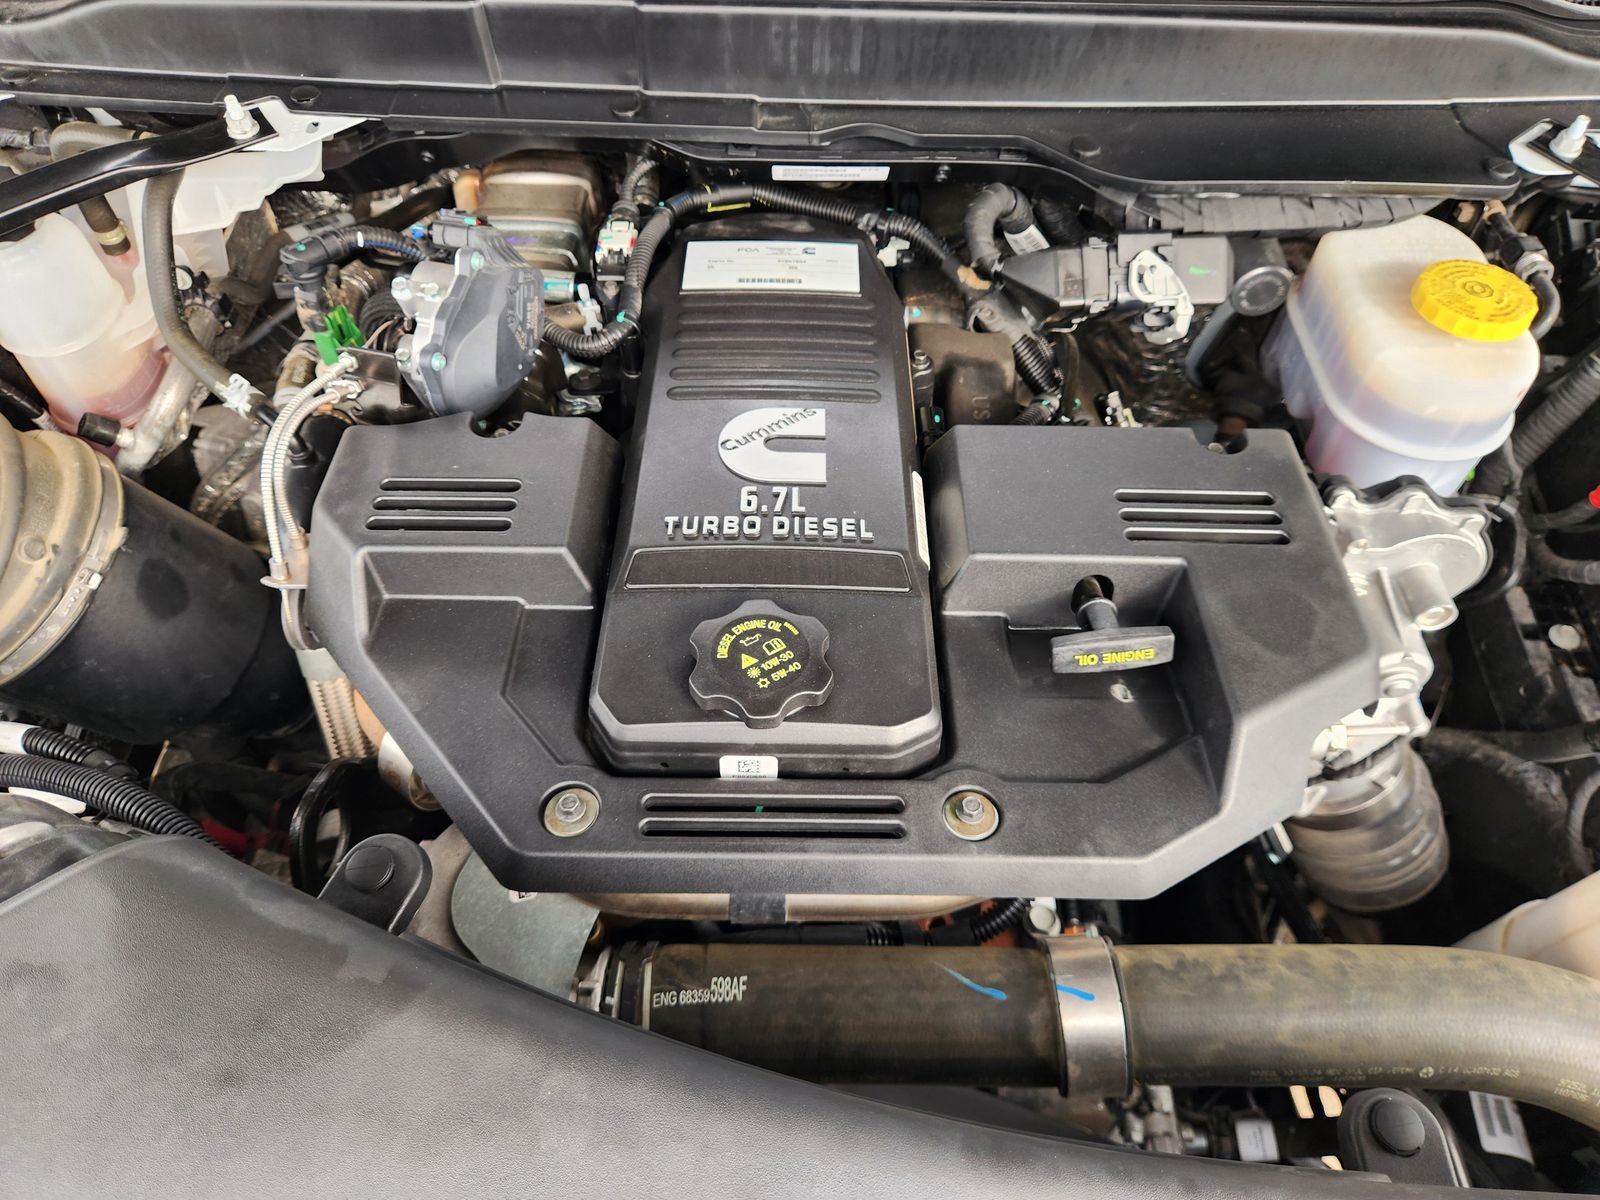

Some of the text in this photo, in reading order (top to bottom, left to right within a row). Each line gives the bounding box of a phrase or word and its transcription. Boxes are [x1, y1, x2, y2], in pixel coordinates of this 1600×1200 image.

[720, 407, 817, 451] Cummins
[740, 486, 807, 515] 6.7L
[664, 515, 875, 542] TURBO DIESEL
[716, 633, 737, 659] DIESEL
[731, 619, 767, 635] ENGINE
[767, 620, 782, 632] OIL
[761, 650, 794, 671] 10W-30
[1075, 648, 1155, 666] ENGINE OIL
[771, 662, 802, 681] 5W-40
[653, 990, 678, 1008] ENG
